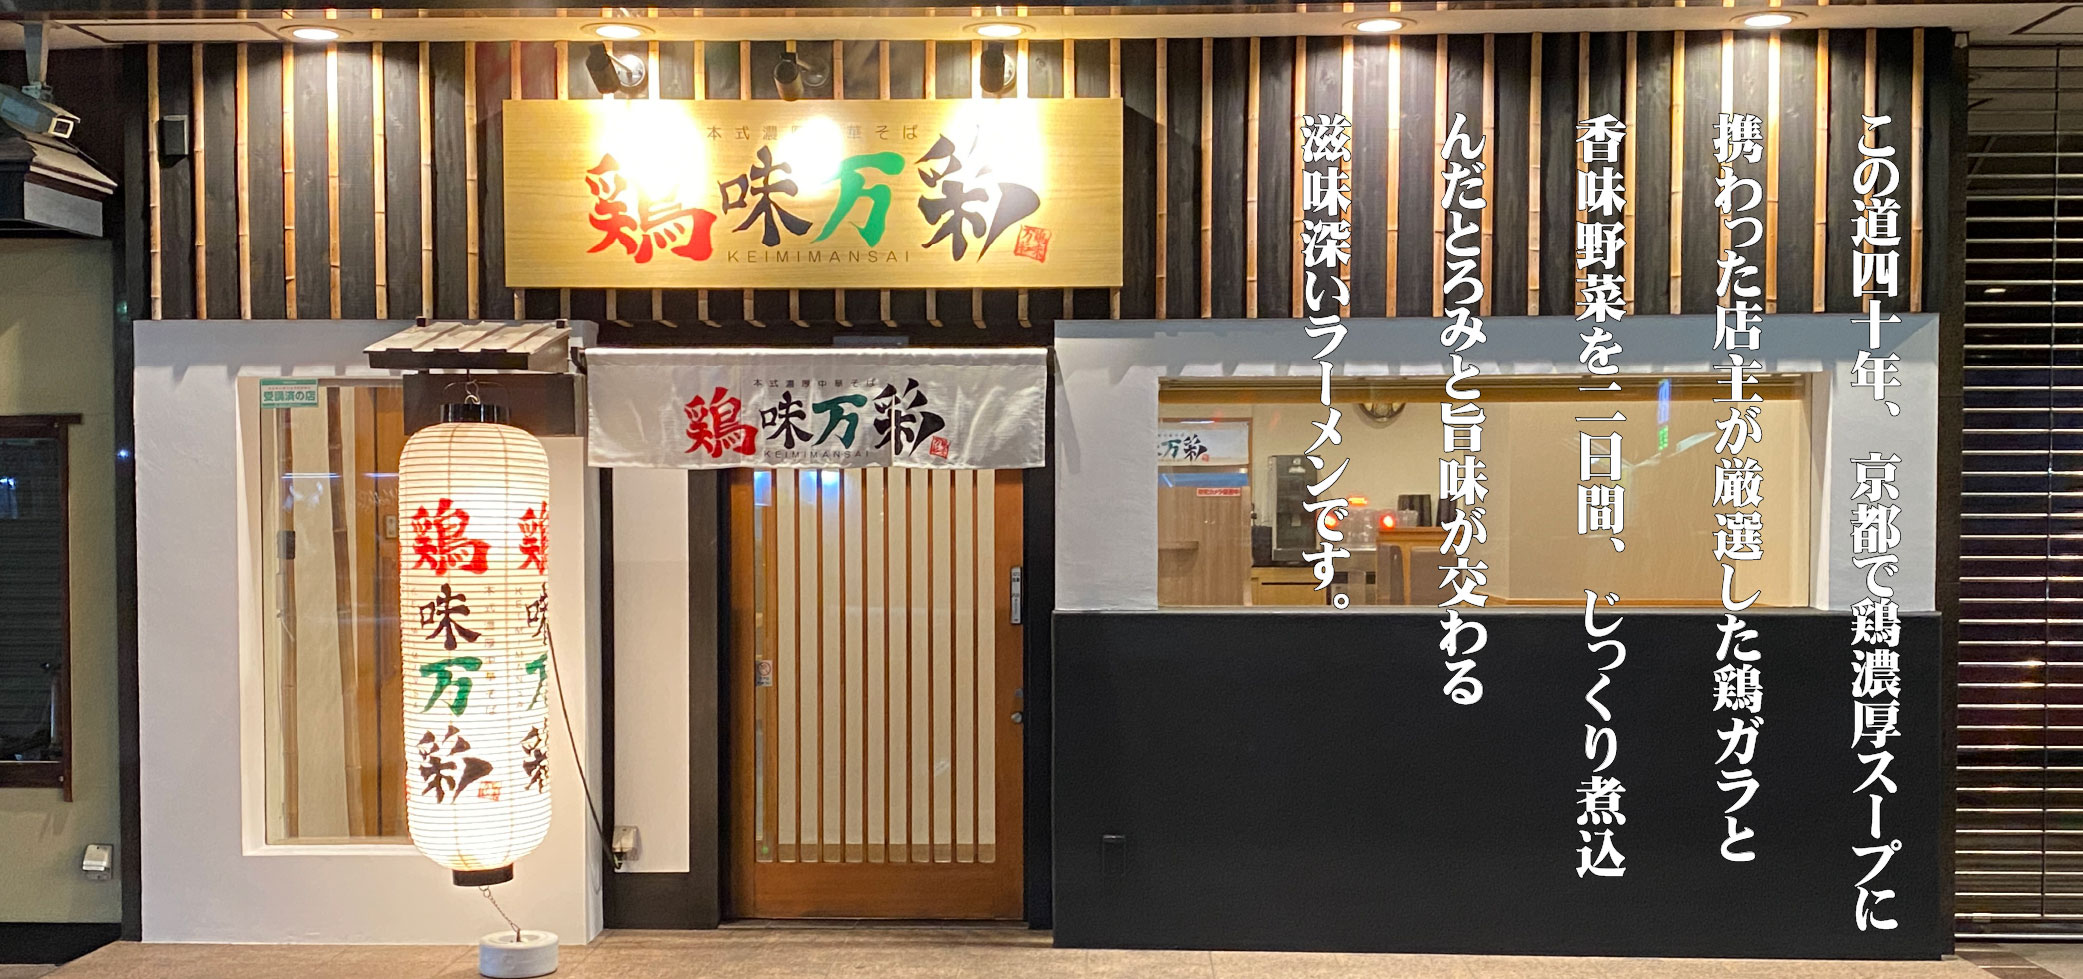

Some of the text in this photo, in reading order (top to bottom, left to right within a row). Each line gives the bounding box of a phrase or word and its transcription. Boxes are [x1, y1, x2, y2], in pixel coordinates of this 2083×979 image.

[727, 250, 910, 263] KEIMIMANSAI
[683, 377, 946, 459] 鶏味万彩
[763, 449, 870, 459] KEIMIMANSAI
[410, 498, 494, 805] 鶏味万彩
